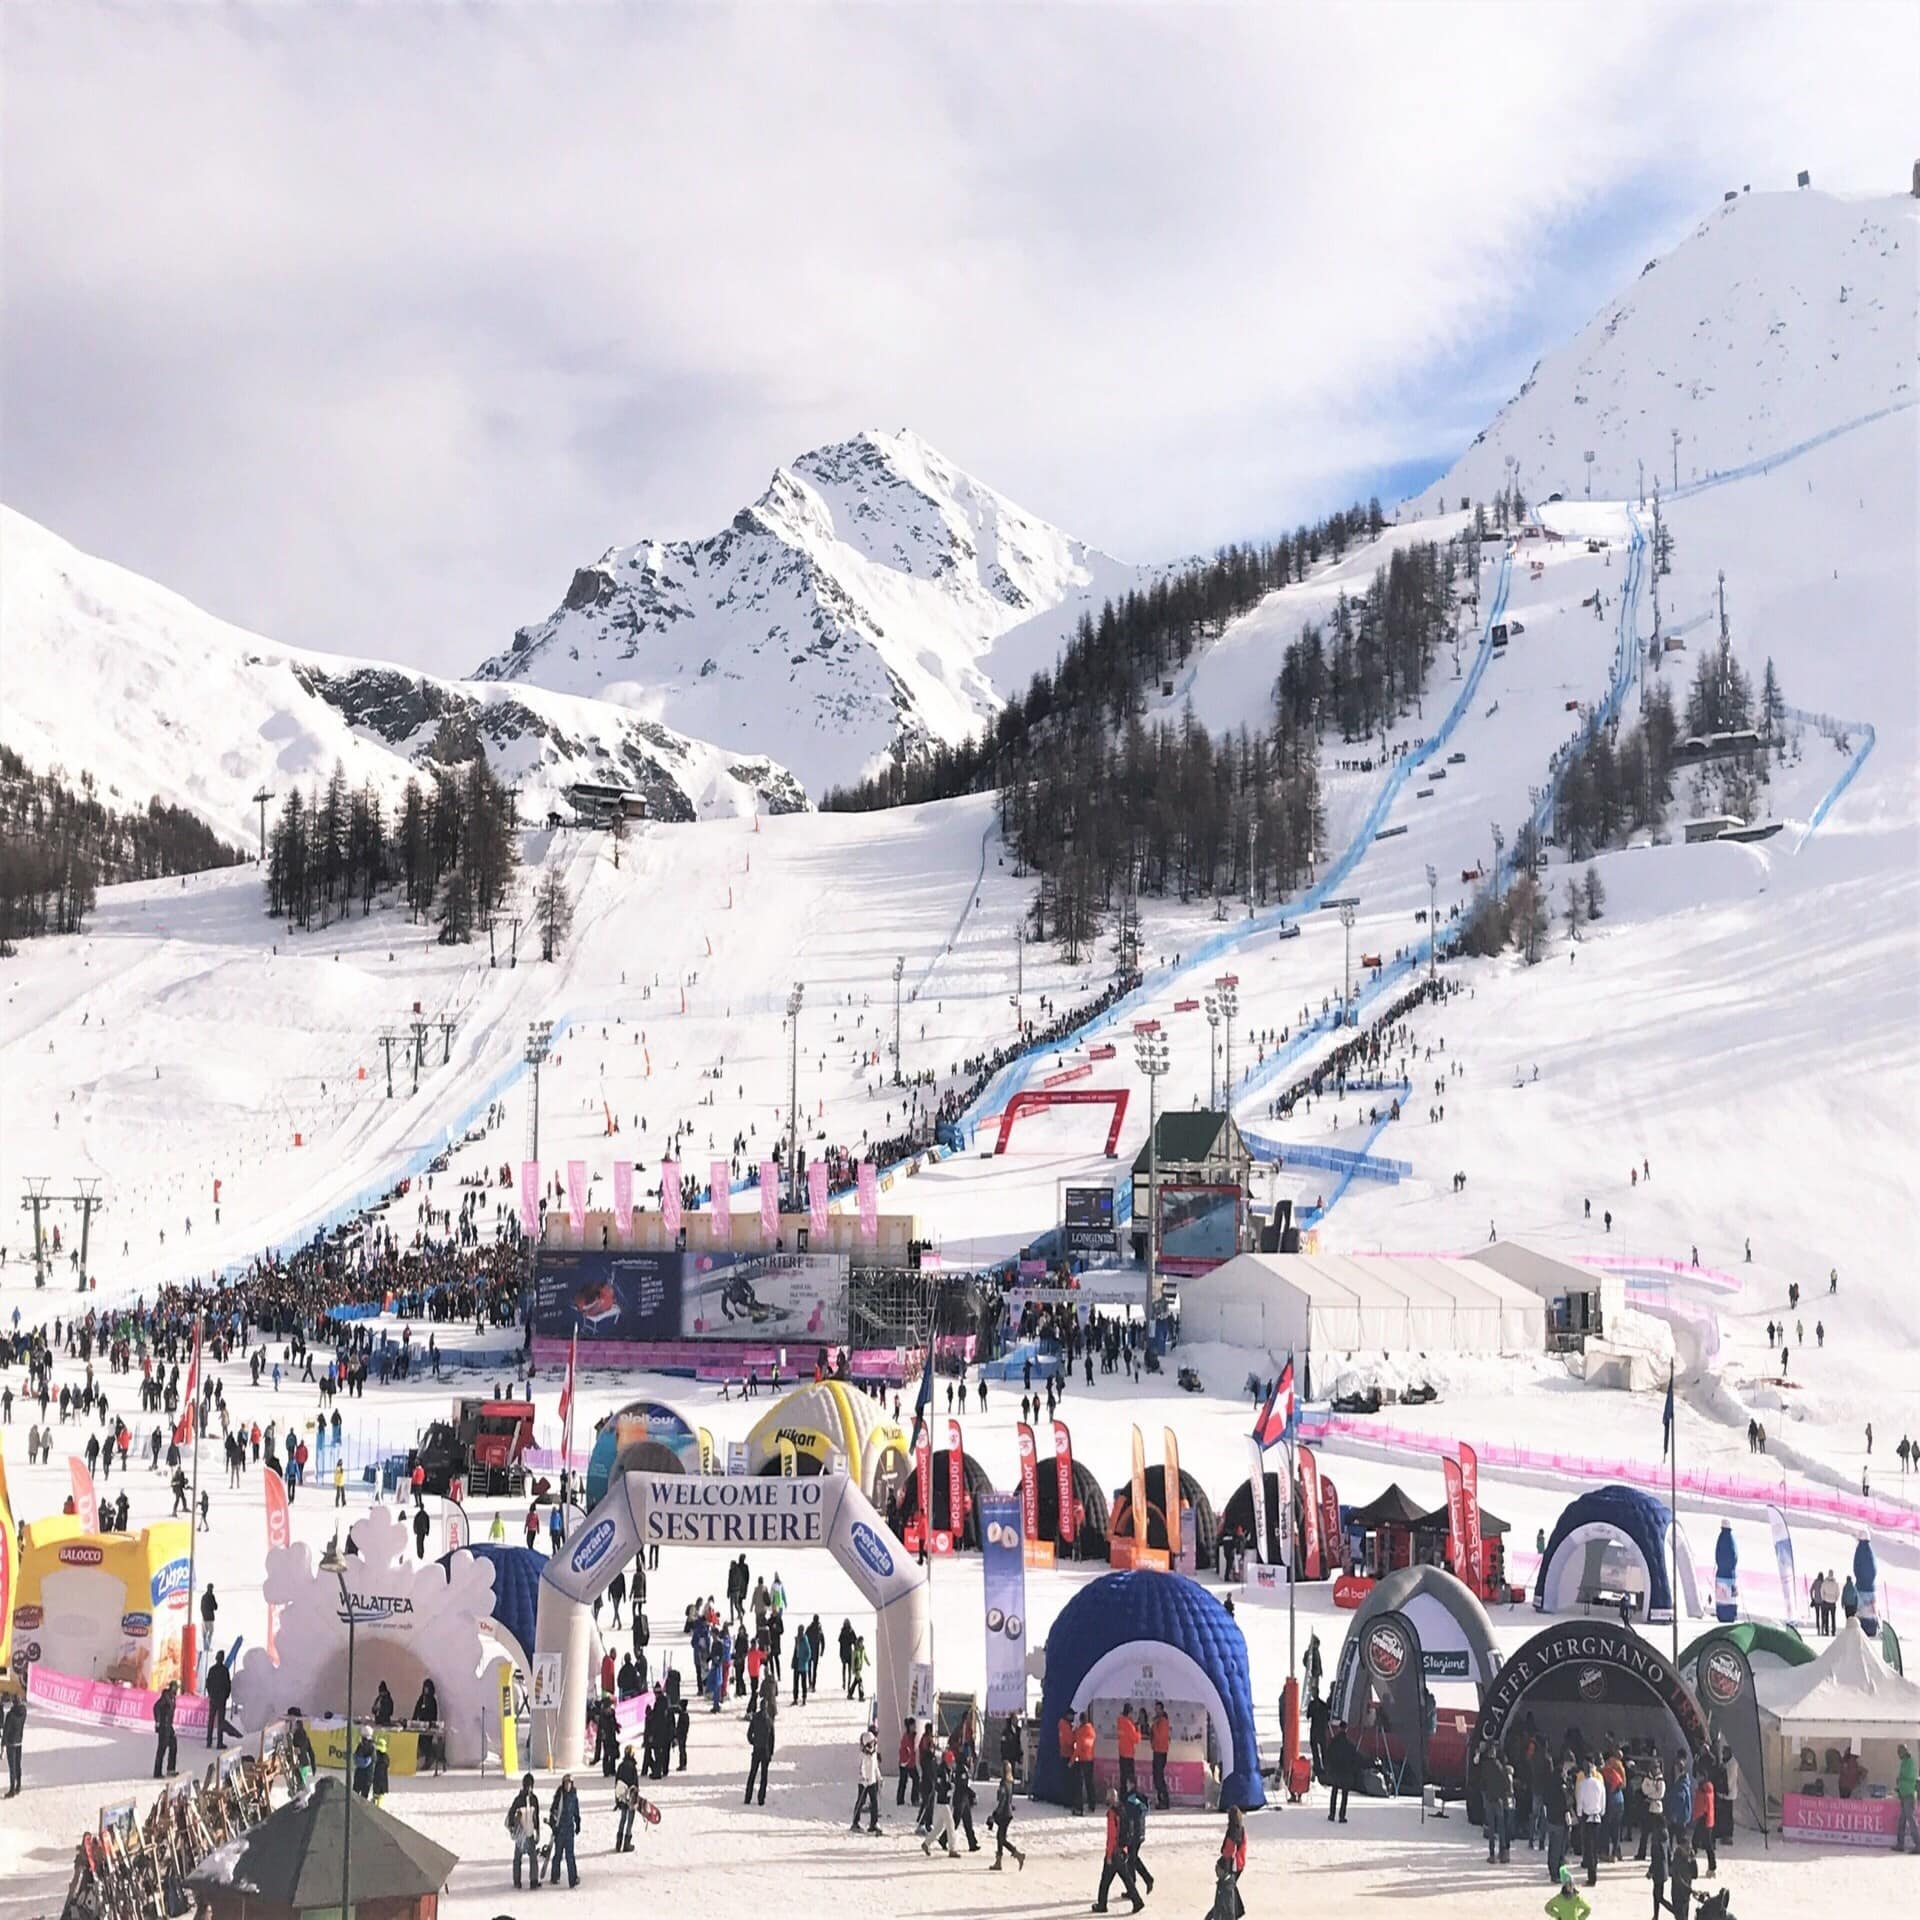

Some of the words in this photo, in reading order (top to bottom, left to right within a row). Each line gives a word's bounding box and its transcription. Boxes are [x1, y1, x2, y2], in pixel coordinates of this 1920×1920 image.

[775, 1428, 816, 1448] Nikon
[651, 1482, 778, 1507] WELCOME
[787, 1483, 821, 1505] TO
[648, 1511, 821, 1542] SESTRIERE
[60, 1550, 101, 1562] BALOCCO
[1482, 1661, 1534, 1740] CAFFÈ
[1536, 1635, 1664, 1683] VERGNANO
[1798, 1809, 1884, 1832] SESTRIERE
